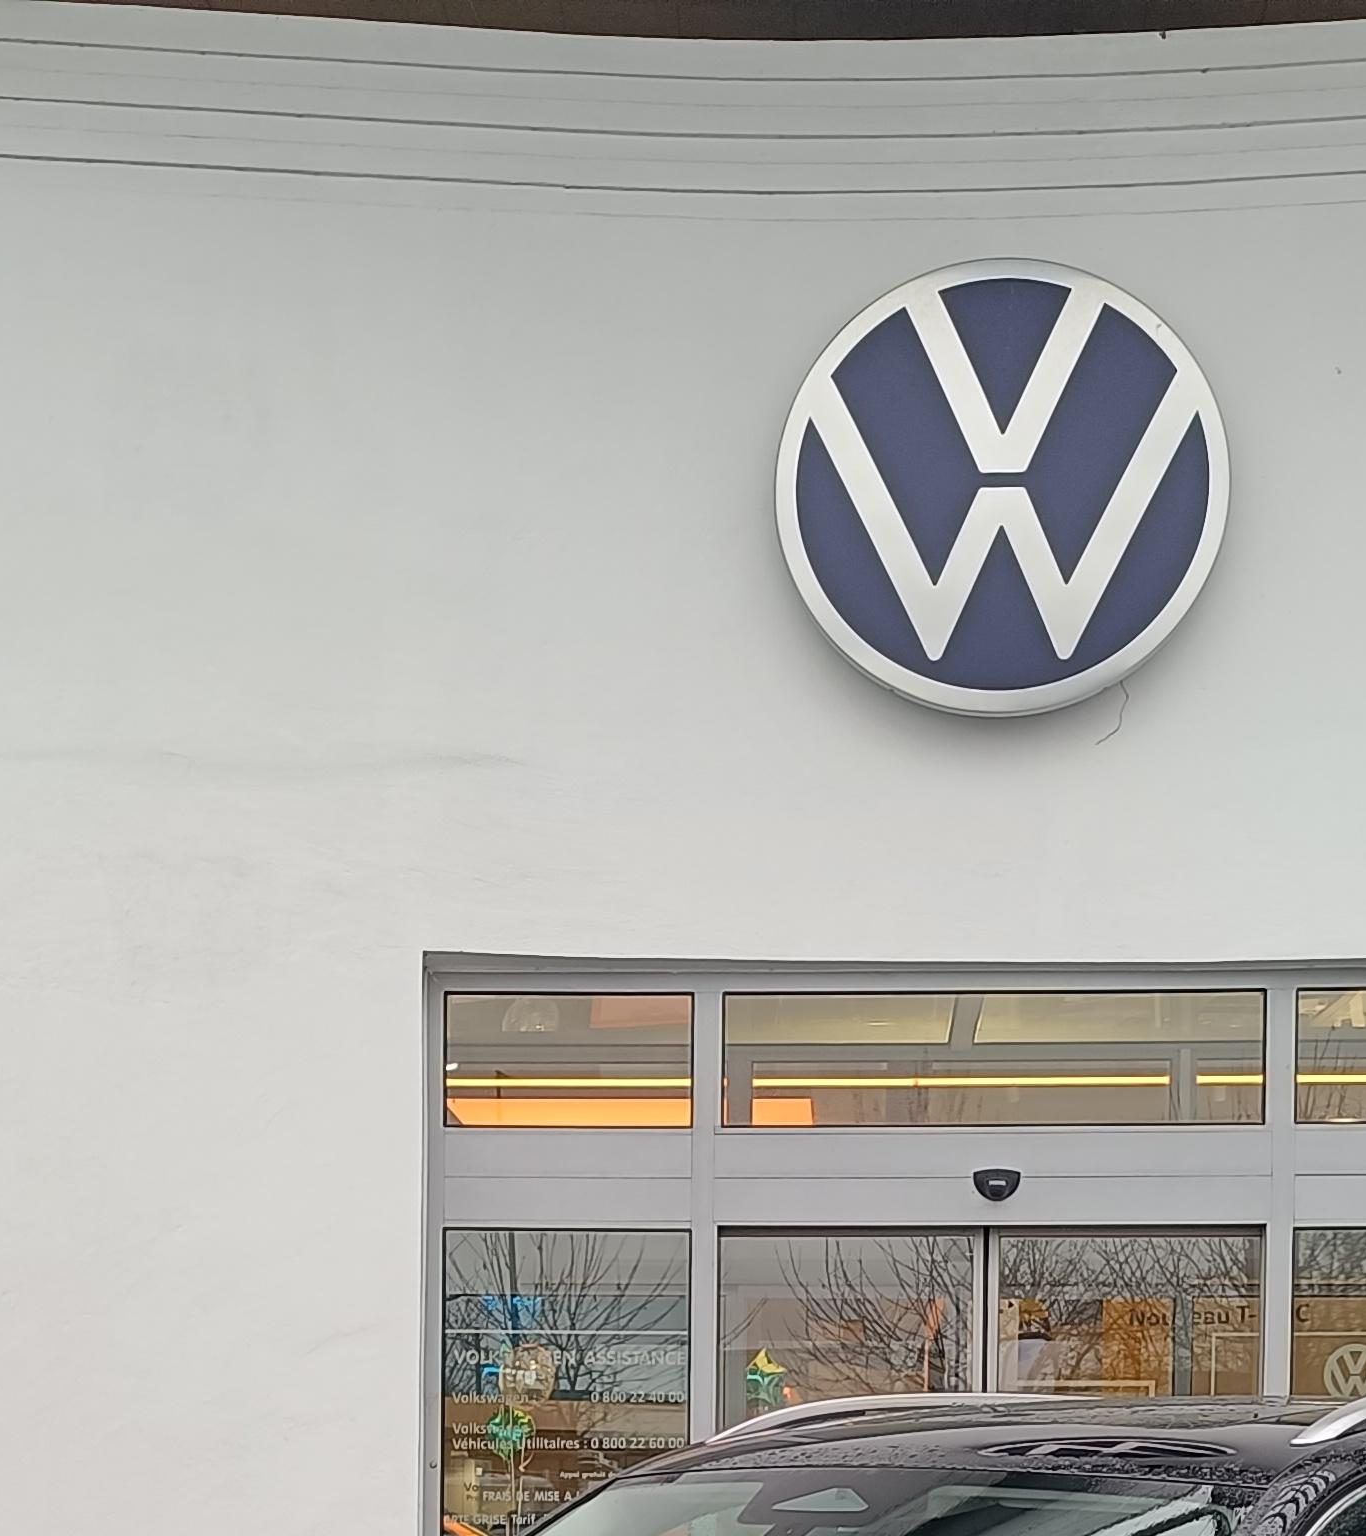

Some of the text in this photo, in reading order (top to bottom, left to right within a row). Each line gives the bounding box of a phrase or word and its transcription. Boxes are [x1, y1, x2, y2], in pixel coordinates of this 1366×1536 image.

[778, 262, 1226, 705] VW
[1130, 1309, 1230, 1326] Noueau
[454, 1350, 685, 1366] VOLKEN ASSISTANCE
[601, 1392, 628, 1403] 800
[630, 1392, 646, 1403] 22
[601, 1437, 628, 1449] 800
[630, 1437, 646, 1449] 22
[649, 1437, 666, 1449] 60
[668, 1437, 684, 1449] 00
[483, 1490, 511, 1502] FRAIS
[534, 1490, 560, 1502] MISE
[473, 1514, 508, 1525] GRISE
[511, 1513, 535, 1525] Tarif
